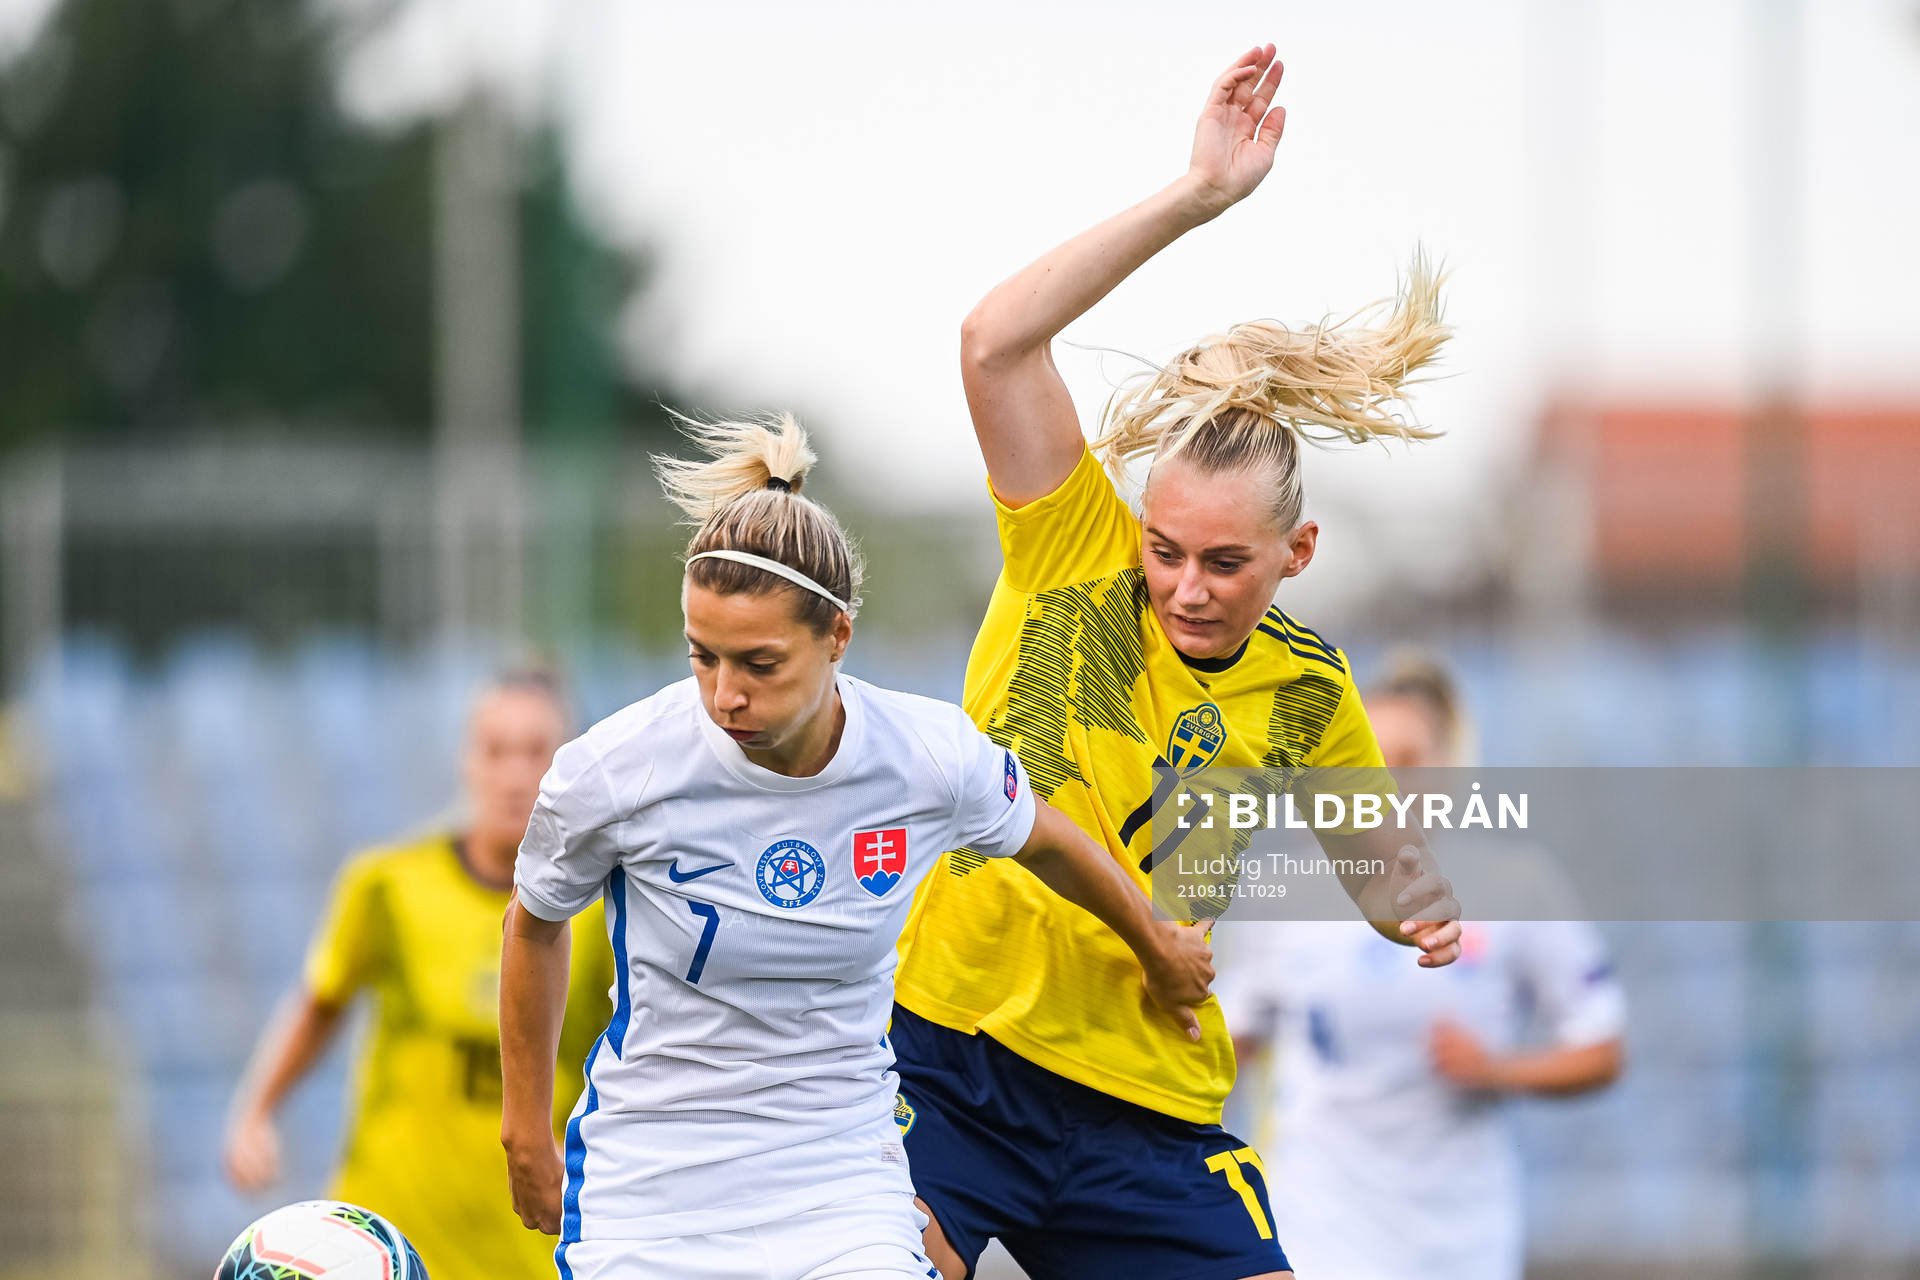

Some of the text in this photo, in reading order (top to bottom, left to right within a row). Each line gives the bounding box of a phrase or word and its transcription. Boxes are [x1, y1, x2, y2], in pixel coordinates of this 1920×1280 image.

[1186, 722, 1216, 741] SVERIGE
[782, 900, 802, 908] SFZ
[685, 900, 720, 984] 7
